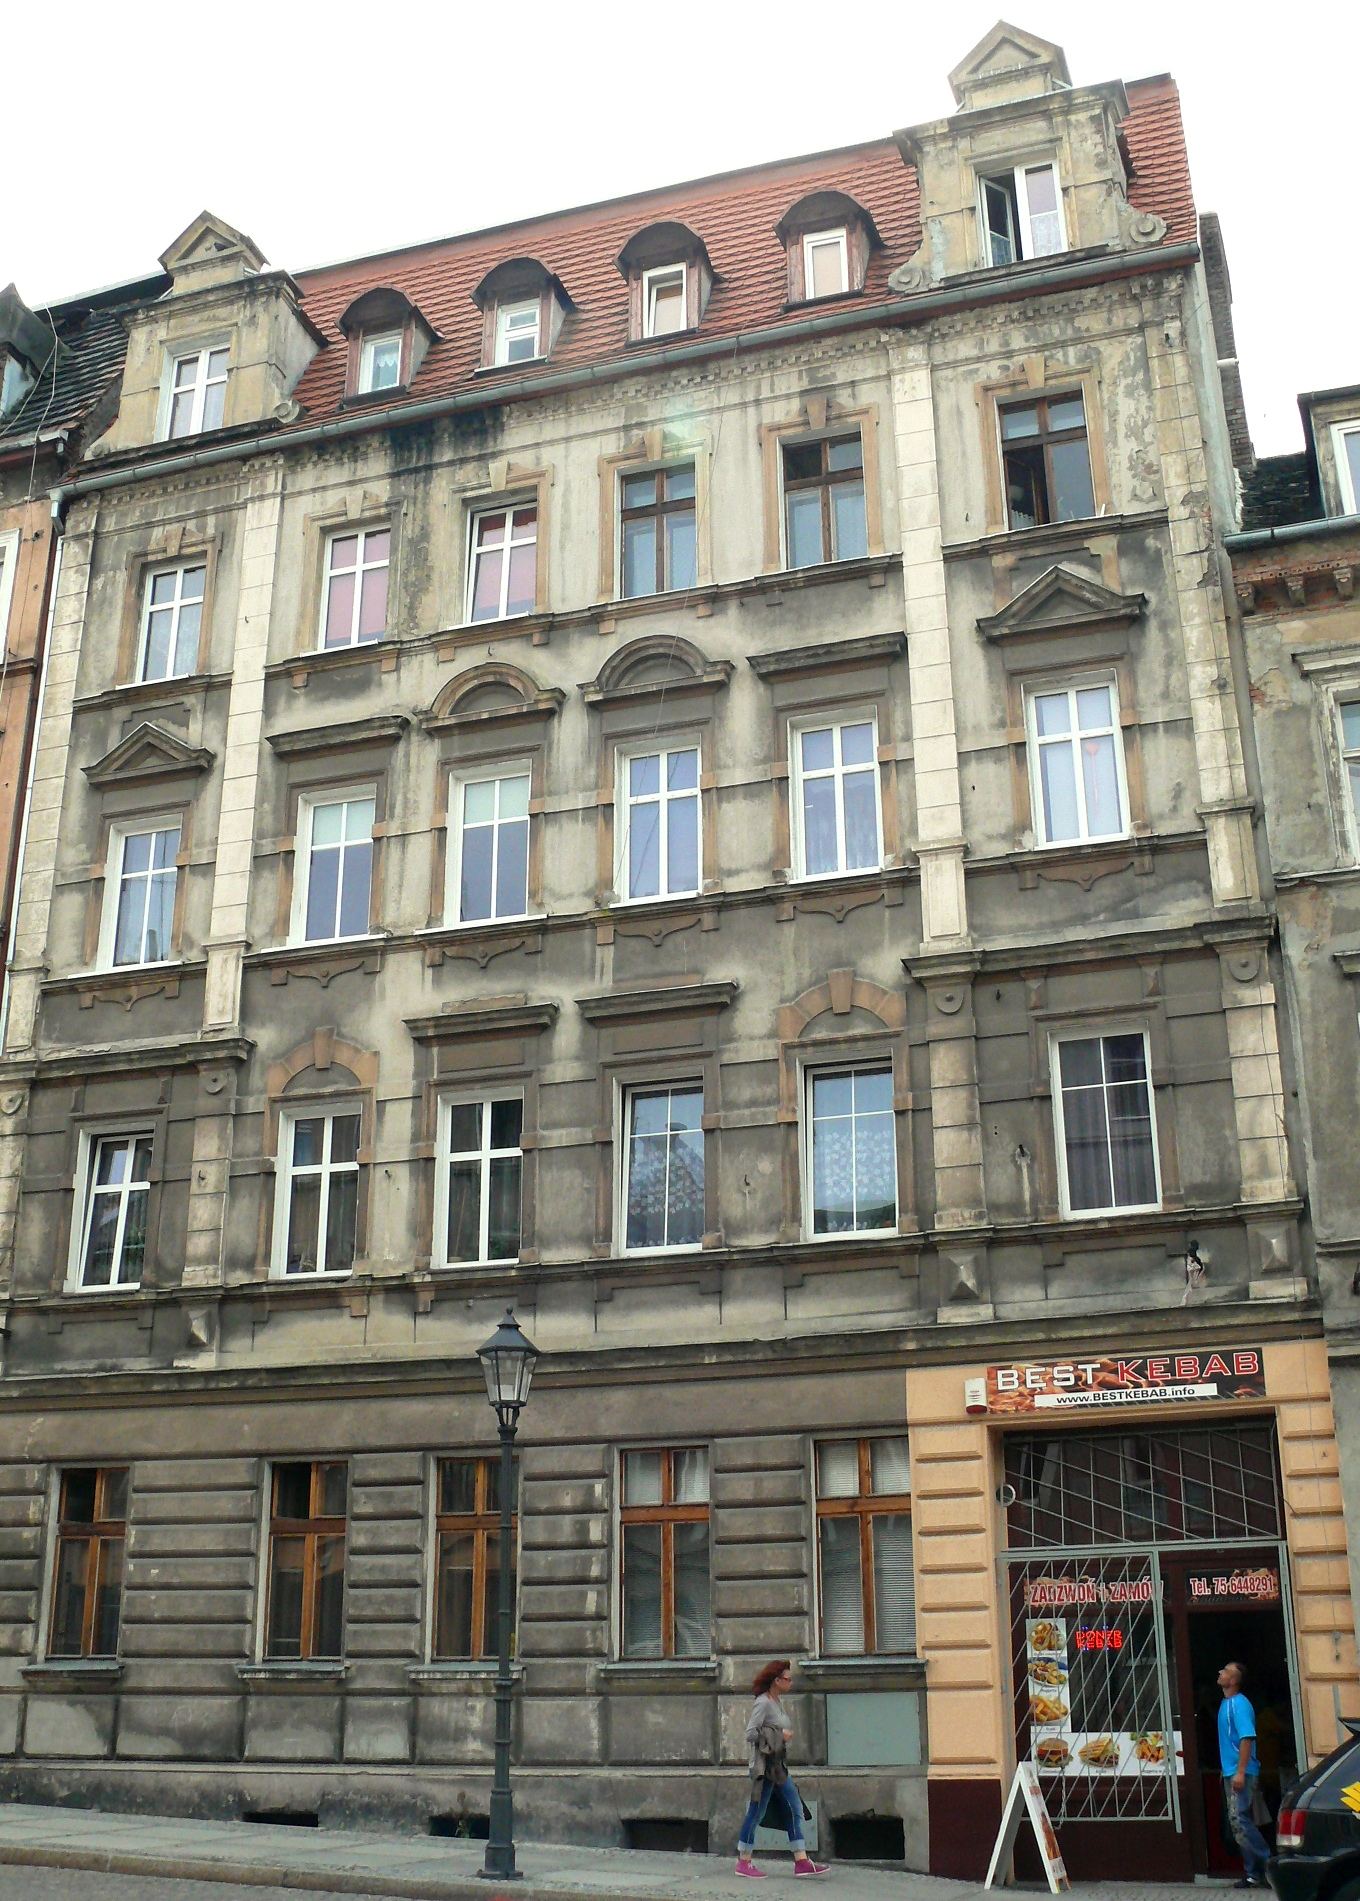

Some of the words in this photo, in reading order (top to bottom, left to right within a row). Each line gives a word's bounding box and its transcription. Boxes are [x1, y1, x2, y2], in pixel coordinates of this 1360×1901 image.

[997, 1363, 1101, 1391] BEST
[1117, 1351, 1259, 1383] KEBAB
[1056, 1387, 1195, 1404] www.BESTKEBAB.info
[1110, 1575, 1164, 1602] ZAMÓ
[1190, 1578, 1211, 1596] Tel.
[1212, 1577, 1227, 1595] 75
[1229, 1574, 1274, 1594] 6448291
